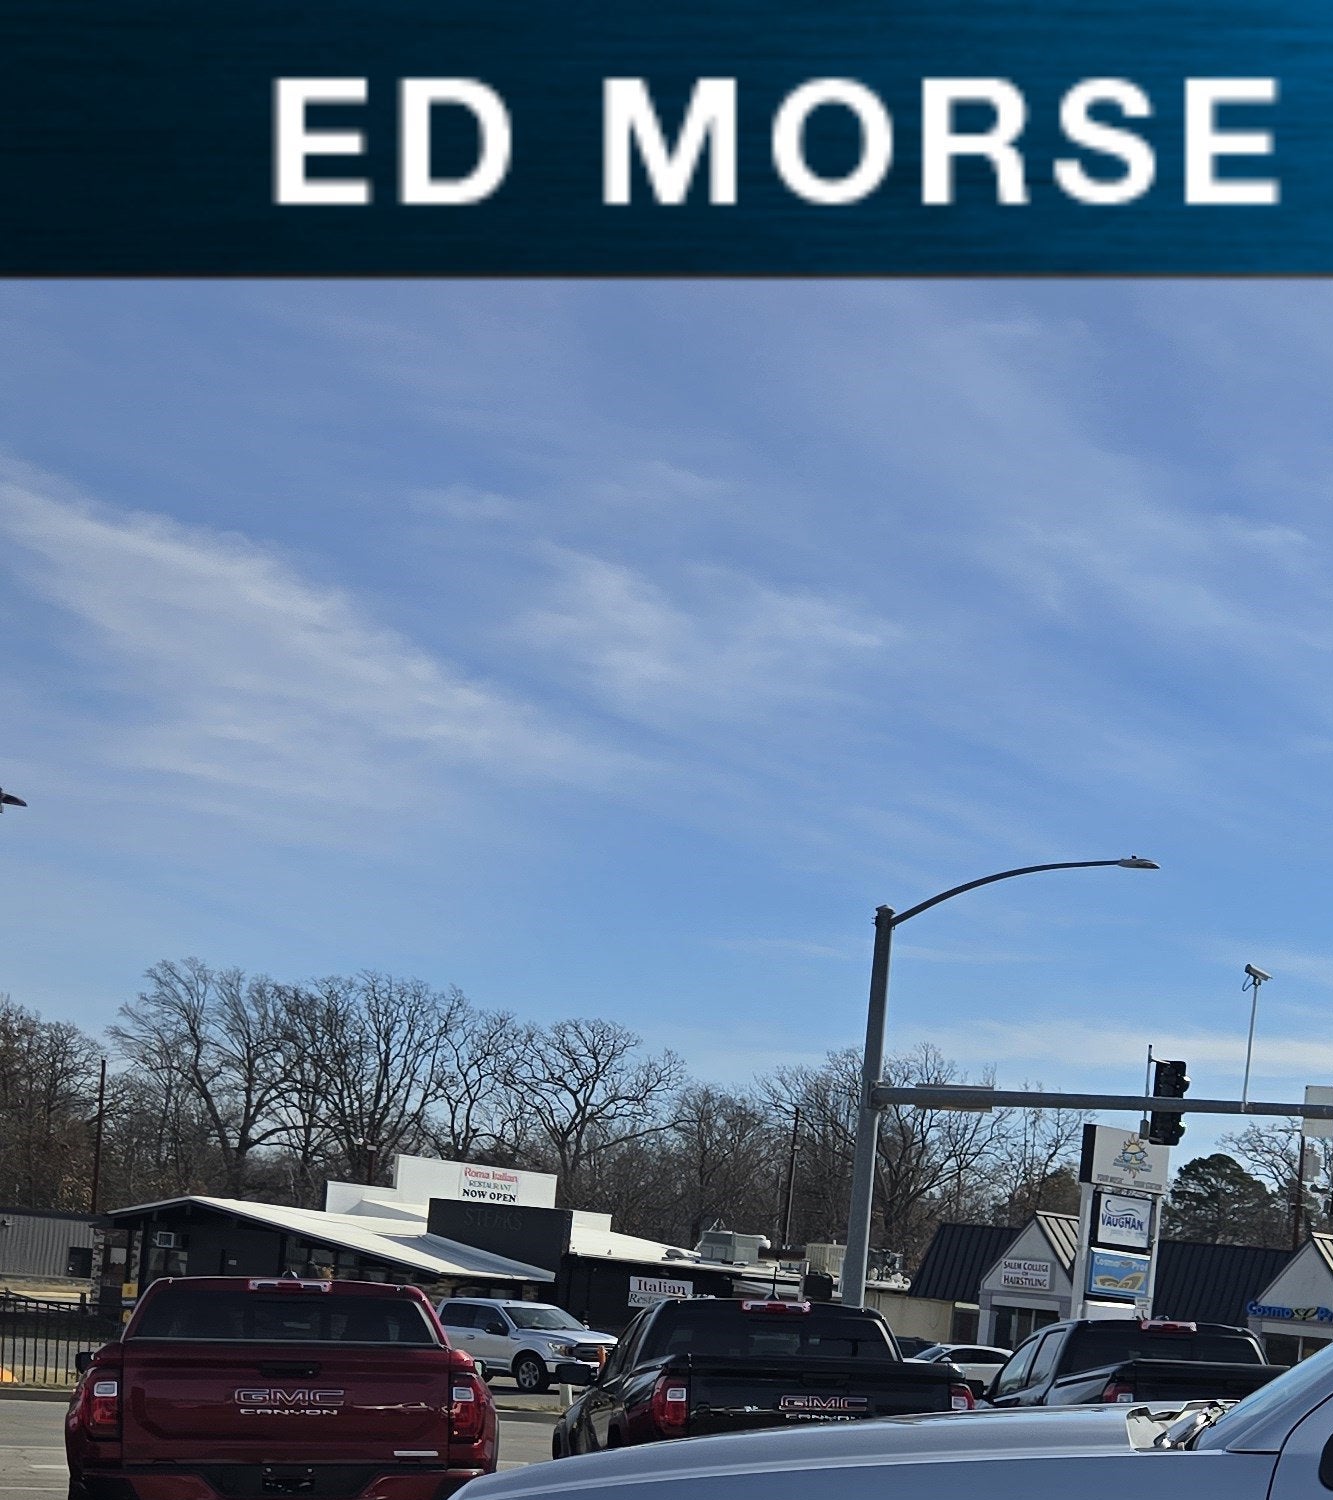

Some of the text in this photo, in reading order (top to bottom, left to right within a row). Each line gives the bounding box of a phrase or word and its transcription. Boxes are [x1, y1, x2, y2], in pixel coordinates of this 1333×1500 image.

[462, 1188, 517, 1203] NOW OPEN
[1101, 1212, 1144, 1232] VAUGHAN
[637, 1279, 687, 1296] Italian
[1247, 1300, 1292, 1319] Cosmo
[234, 1388, 345, 1407] GMC
[779, 1395, 868, 1412] GMC
[239, 1408, 338, 1416] CANYON
